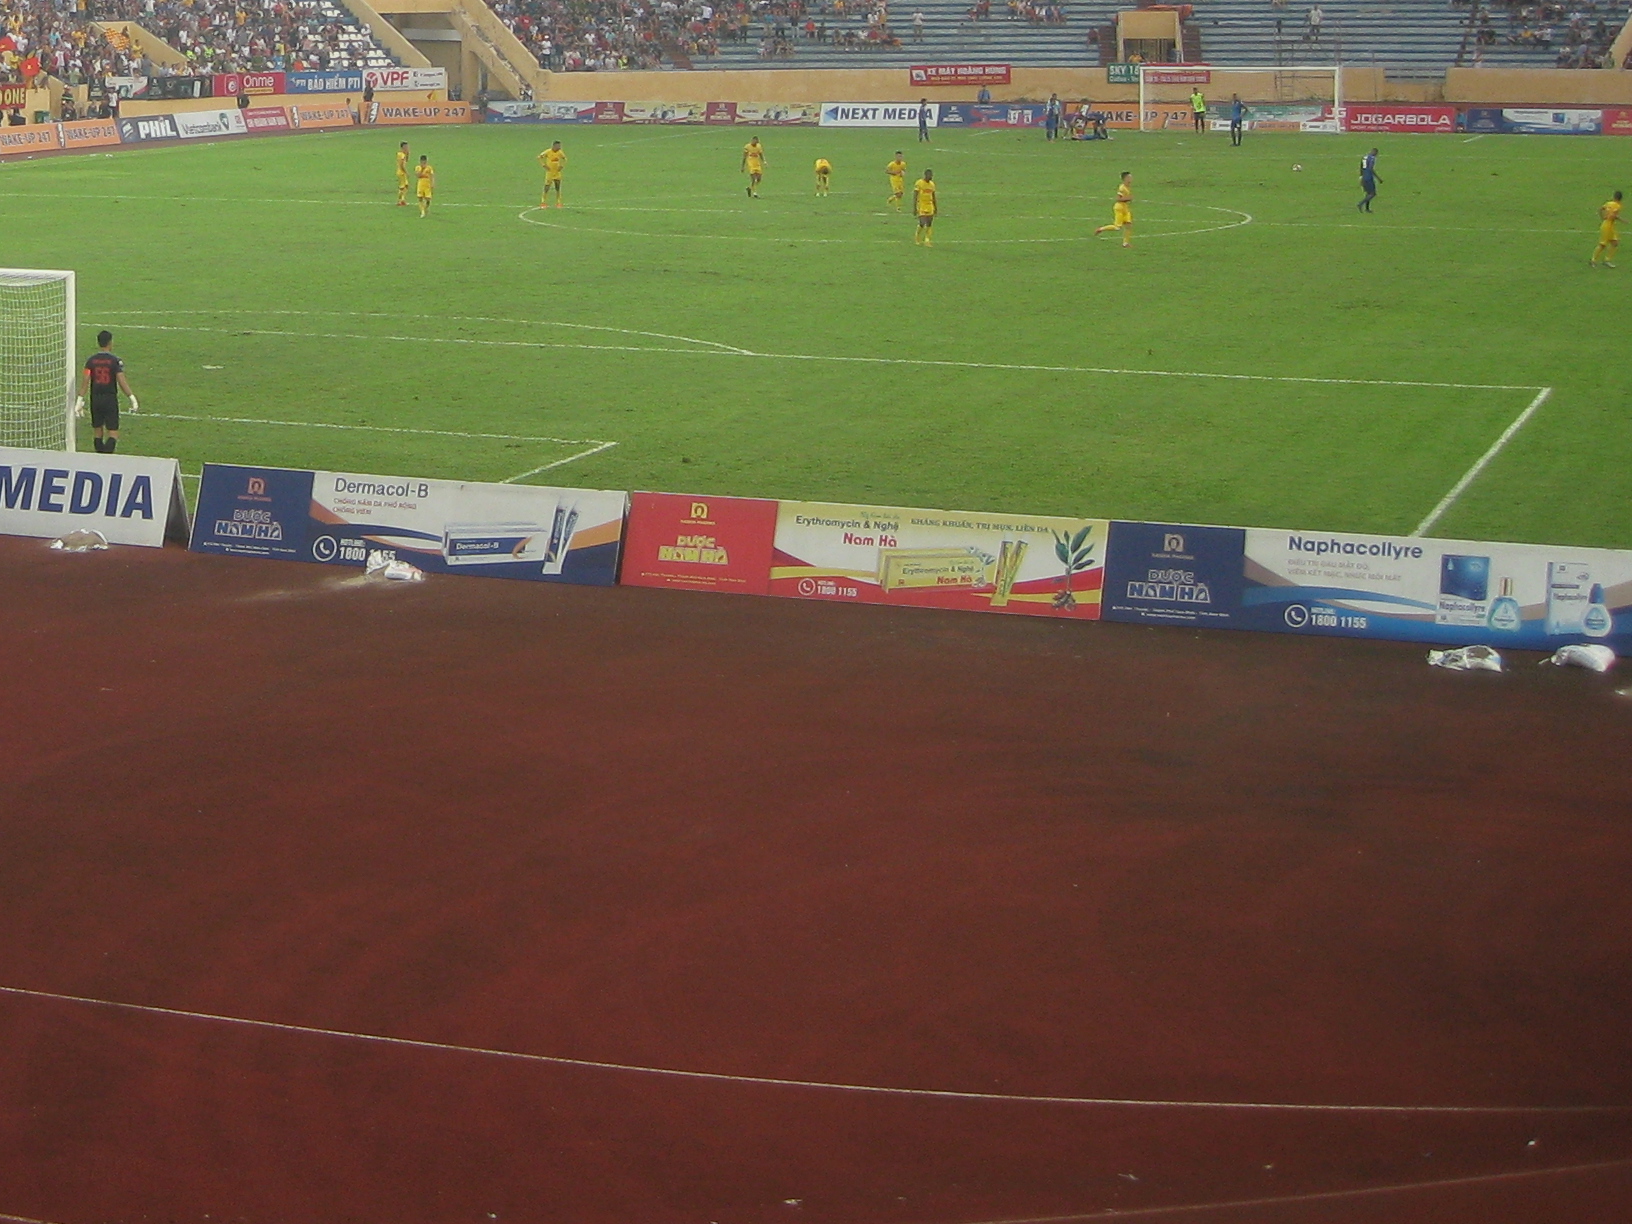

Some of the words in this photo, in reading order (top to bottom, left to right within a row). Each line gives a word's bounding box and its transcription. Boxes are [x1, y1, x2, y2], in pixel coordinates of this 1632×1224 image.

[243, 75, 274, 87] Onme
[348, 77, 360, 89] PTI
[380, 71, 409, 86] VPF
[5, 88, 25, 104] ONE
[382, 107, 440, 118] WAKE-UP
[444, 107, 466, 116] 247
[840, 107, 877, 120] NEXT
[883, 107, 933, 120] MEDA
[1351, 114, 1451, 125] JOGARBOLA
[0, 133, 36, 147] WAKE-UP
[38, 131, 51, 144] 247
[66, 129, 101, 142] WAKE-UP
[334, 477, 429, 498] Dermacol-B
[796, 515, 860, 529] Erythromycin
[864, 521, 870, 529] &
[874, 521, 899, 532] Nghệ
[456, 541, 499, 550] Dermacol-B
[843, 532, 874, 546] Nam
[879, 535, 897, 548] Hà
[1288, 536, 1423, 560] Naphacollyre
[937, 576, 958, 584] Nam
[1311, 614, 1337, 626] 1800
[1340, 616, 1366, 628] 1155
